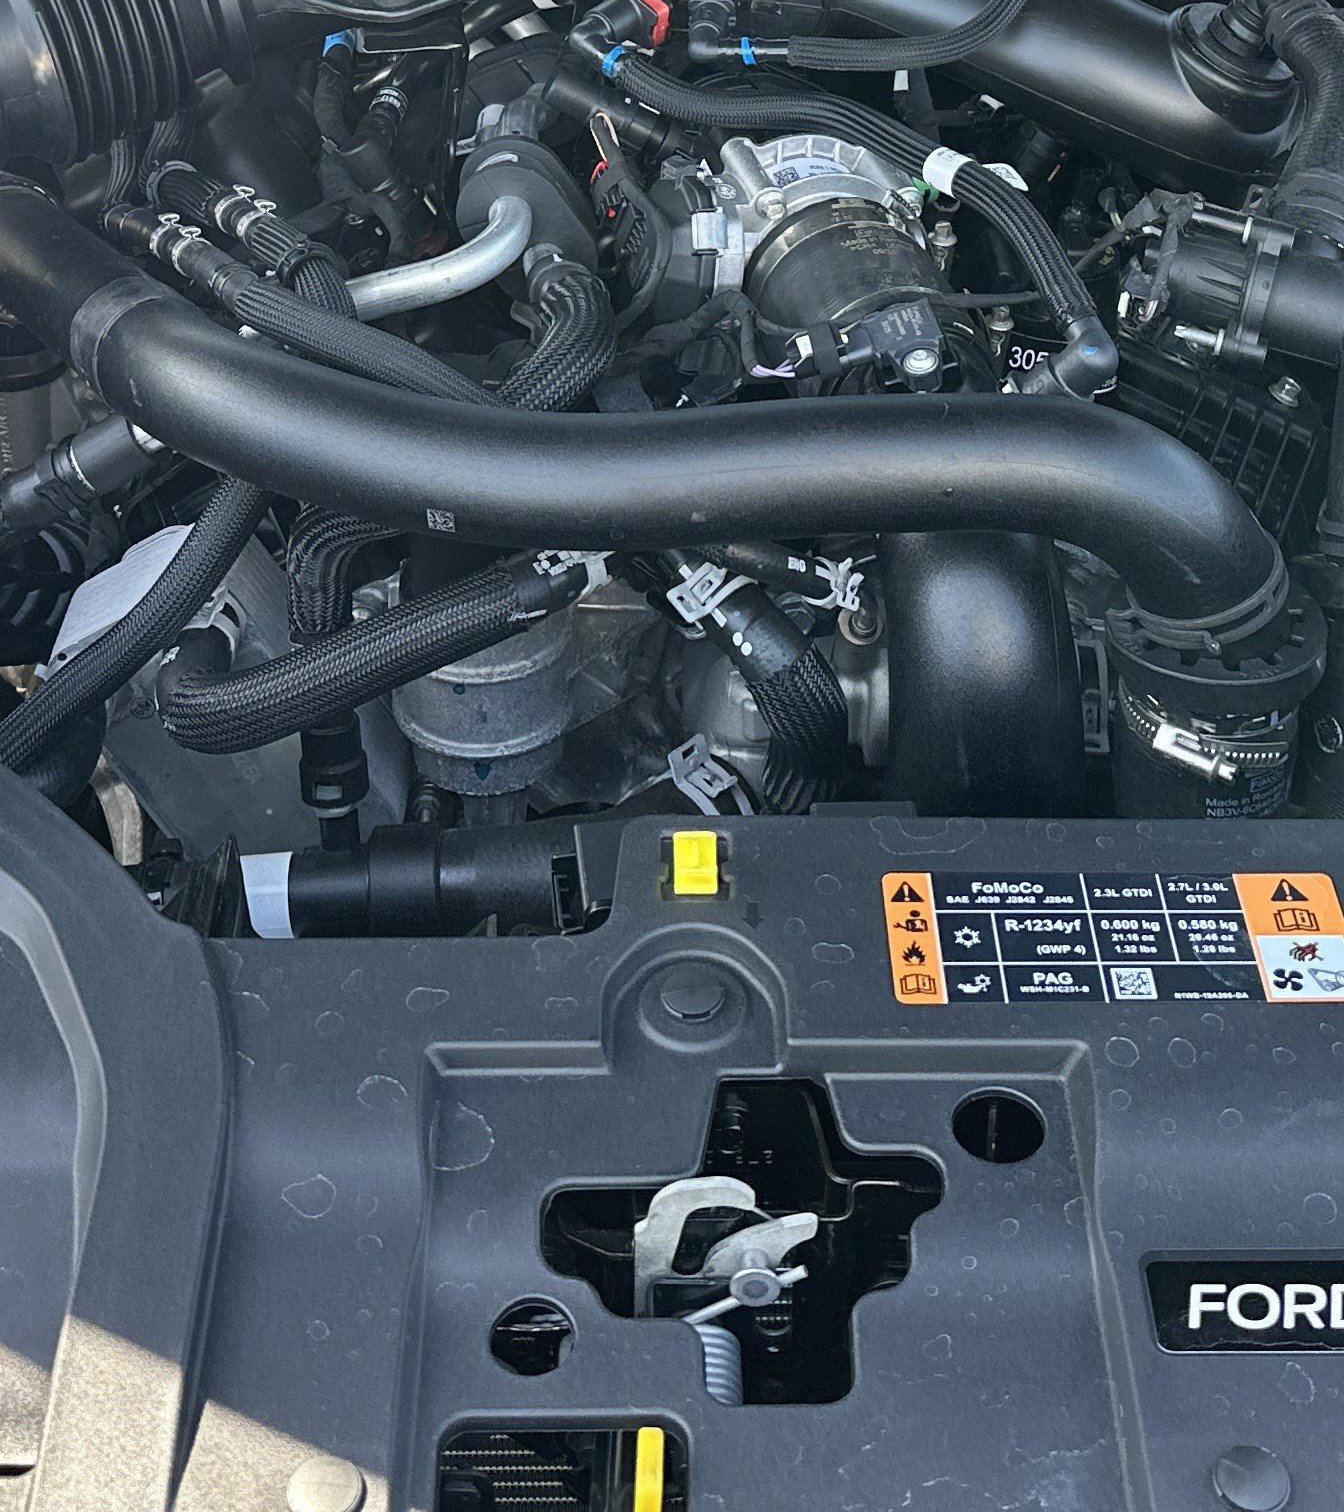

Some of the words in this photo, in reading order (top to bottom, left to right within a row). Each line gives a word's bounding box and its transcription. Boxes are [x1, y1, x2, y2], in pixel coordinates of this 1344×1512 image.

[1205, 798, 1239, 807] Made
[971, 881, 1044, 894] FoMoCo
[1167, 882, 1194, 892] 2.7L
[1202, 882, 1229, 892] 3.0L
[1093, 888, 1120, 898] 2.3L
[1122, 888, 1153, 898] GTDI
[946, 895, 970, 904] SAE
[974, 896, 1001, 904] J639
[1185, 894, 1217, 904] GTDI
[1004, 918, 1082, 934] R-1234yf
[1100, 919, 1139, 930] 0.600
[1142, 919, 1161, 932] kg
[1177, 919, 1217, 930] 0.580
[1219, 919, 1239, 932] kg
[1111, 933, 1140, 942] 21.16
[1141, 934, 1155, 942] oz
[1188, 933, 1218, 942] 20.46
[1220, 934, 1234, 942] oz
[1036, 944, 1071, 956] (GWP
[1073, 944, 1087, 956] 4)
[1114, 944, 1138, 954] 1.32
[1139, 944, 1158, 954] lbs
[1192, 944, 1216, 954] 1.28
[1217, 944, 1236, 954] lbs
[1033, 972, 1073, 985] PAG
